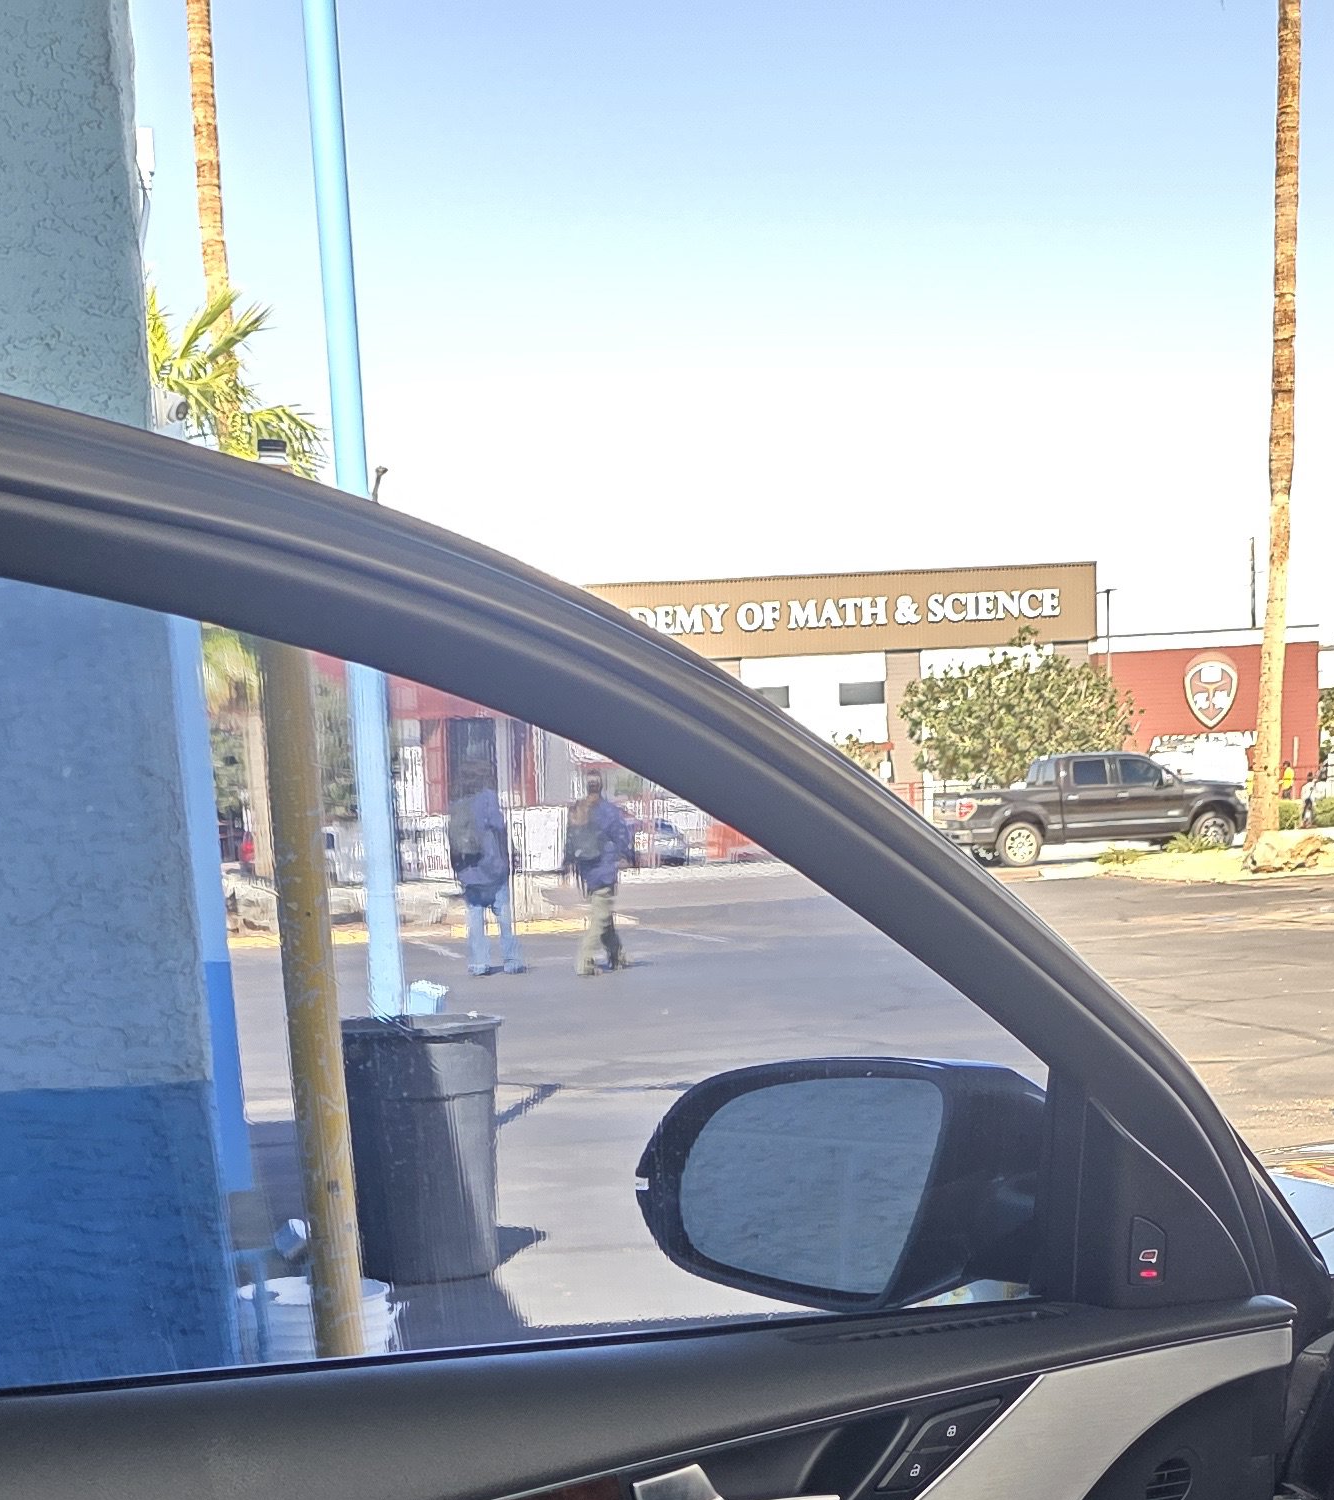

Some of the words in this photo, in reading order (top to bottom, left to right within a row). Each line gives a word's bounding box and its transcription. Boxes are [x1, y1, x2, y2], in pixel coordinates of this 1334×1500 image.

[628, 603, 730, 635] DEMY
[736, 600, 781, 632] OF
[787, 596, 888, 631] MATH
[894, 594, 922, 625] &
[927, 588, 1061, 624] SCIENCE
